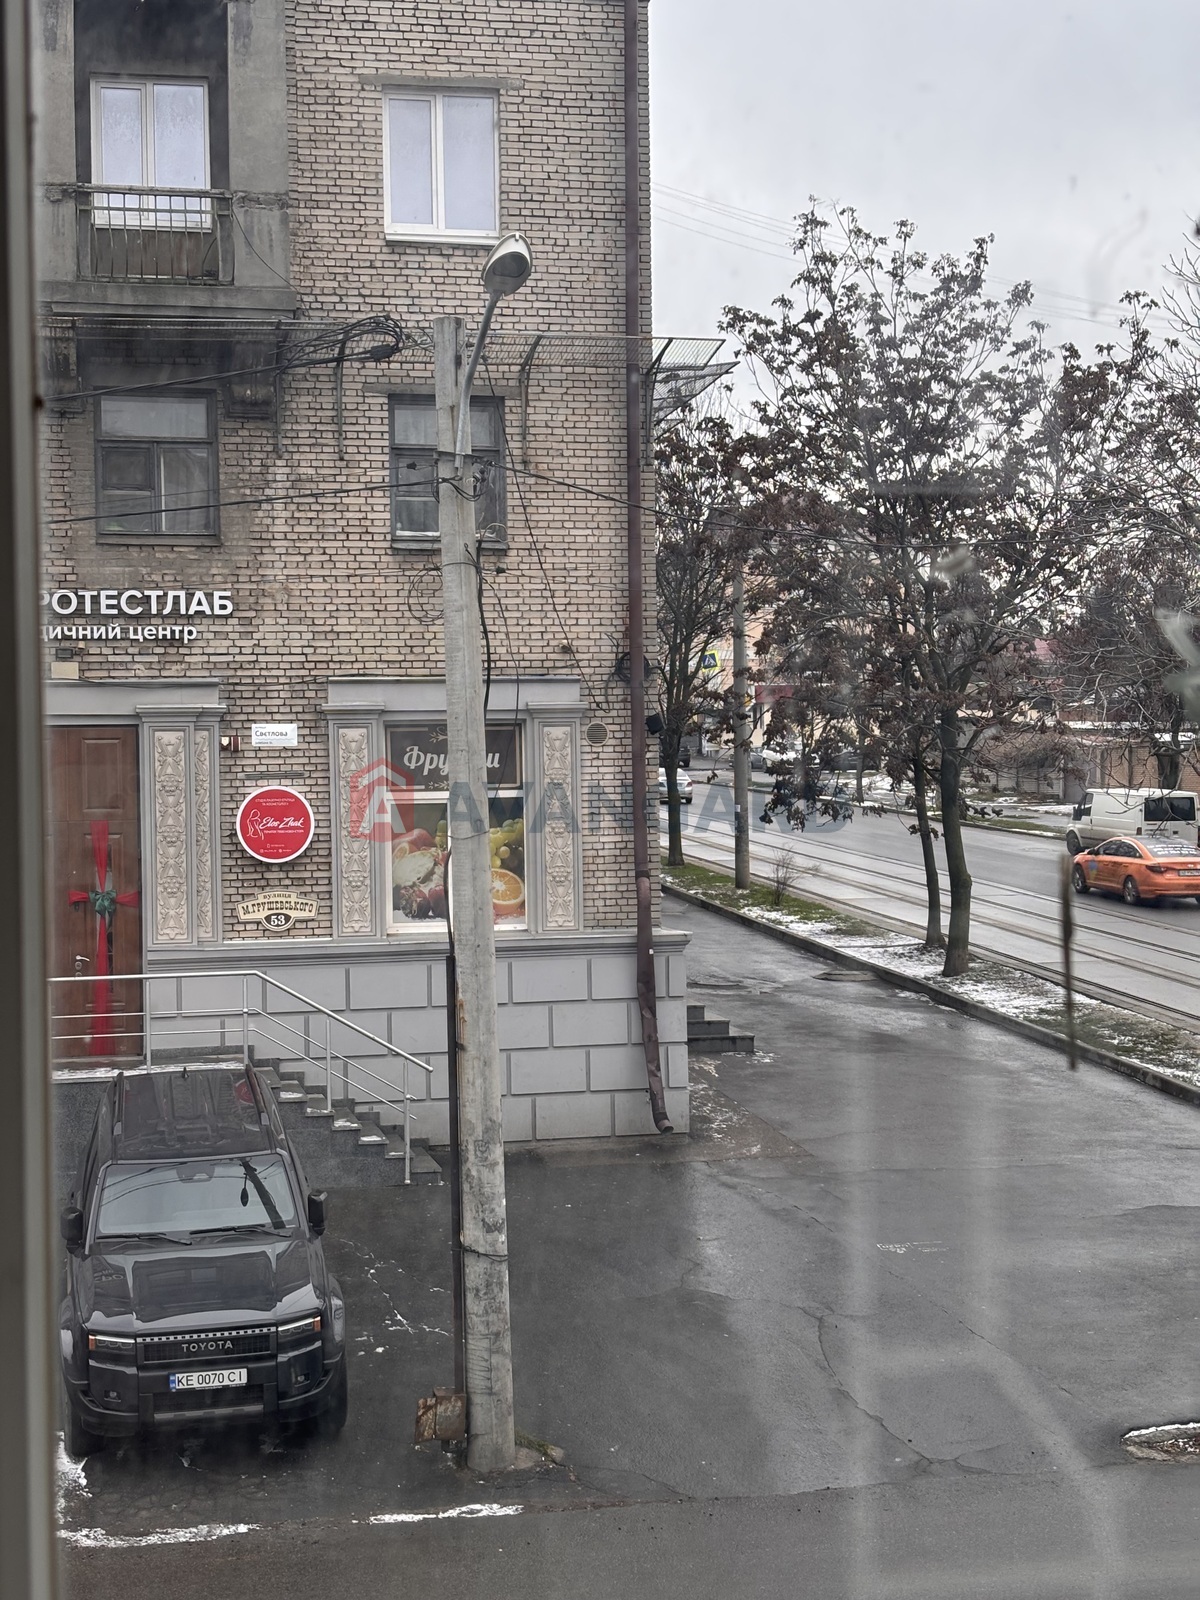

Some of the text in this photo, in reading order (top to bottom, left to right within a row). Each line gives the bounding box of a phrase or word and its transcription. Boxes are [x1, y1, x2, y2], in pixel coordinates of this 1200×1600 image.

[129, 625, 197, 643] центр
[403, 745, 500, 776] Фруи
[270, 914, 286, 926] 53
[181, 1340, 233, 1353] TOYOTA
[177, 1375, 194, 1387] KE
[197, 1372, 225, 1385] 0070
